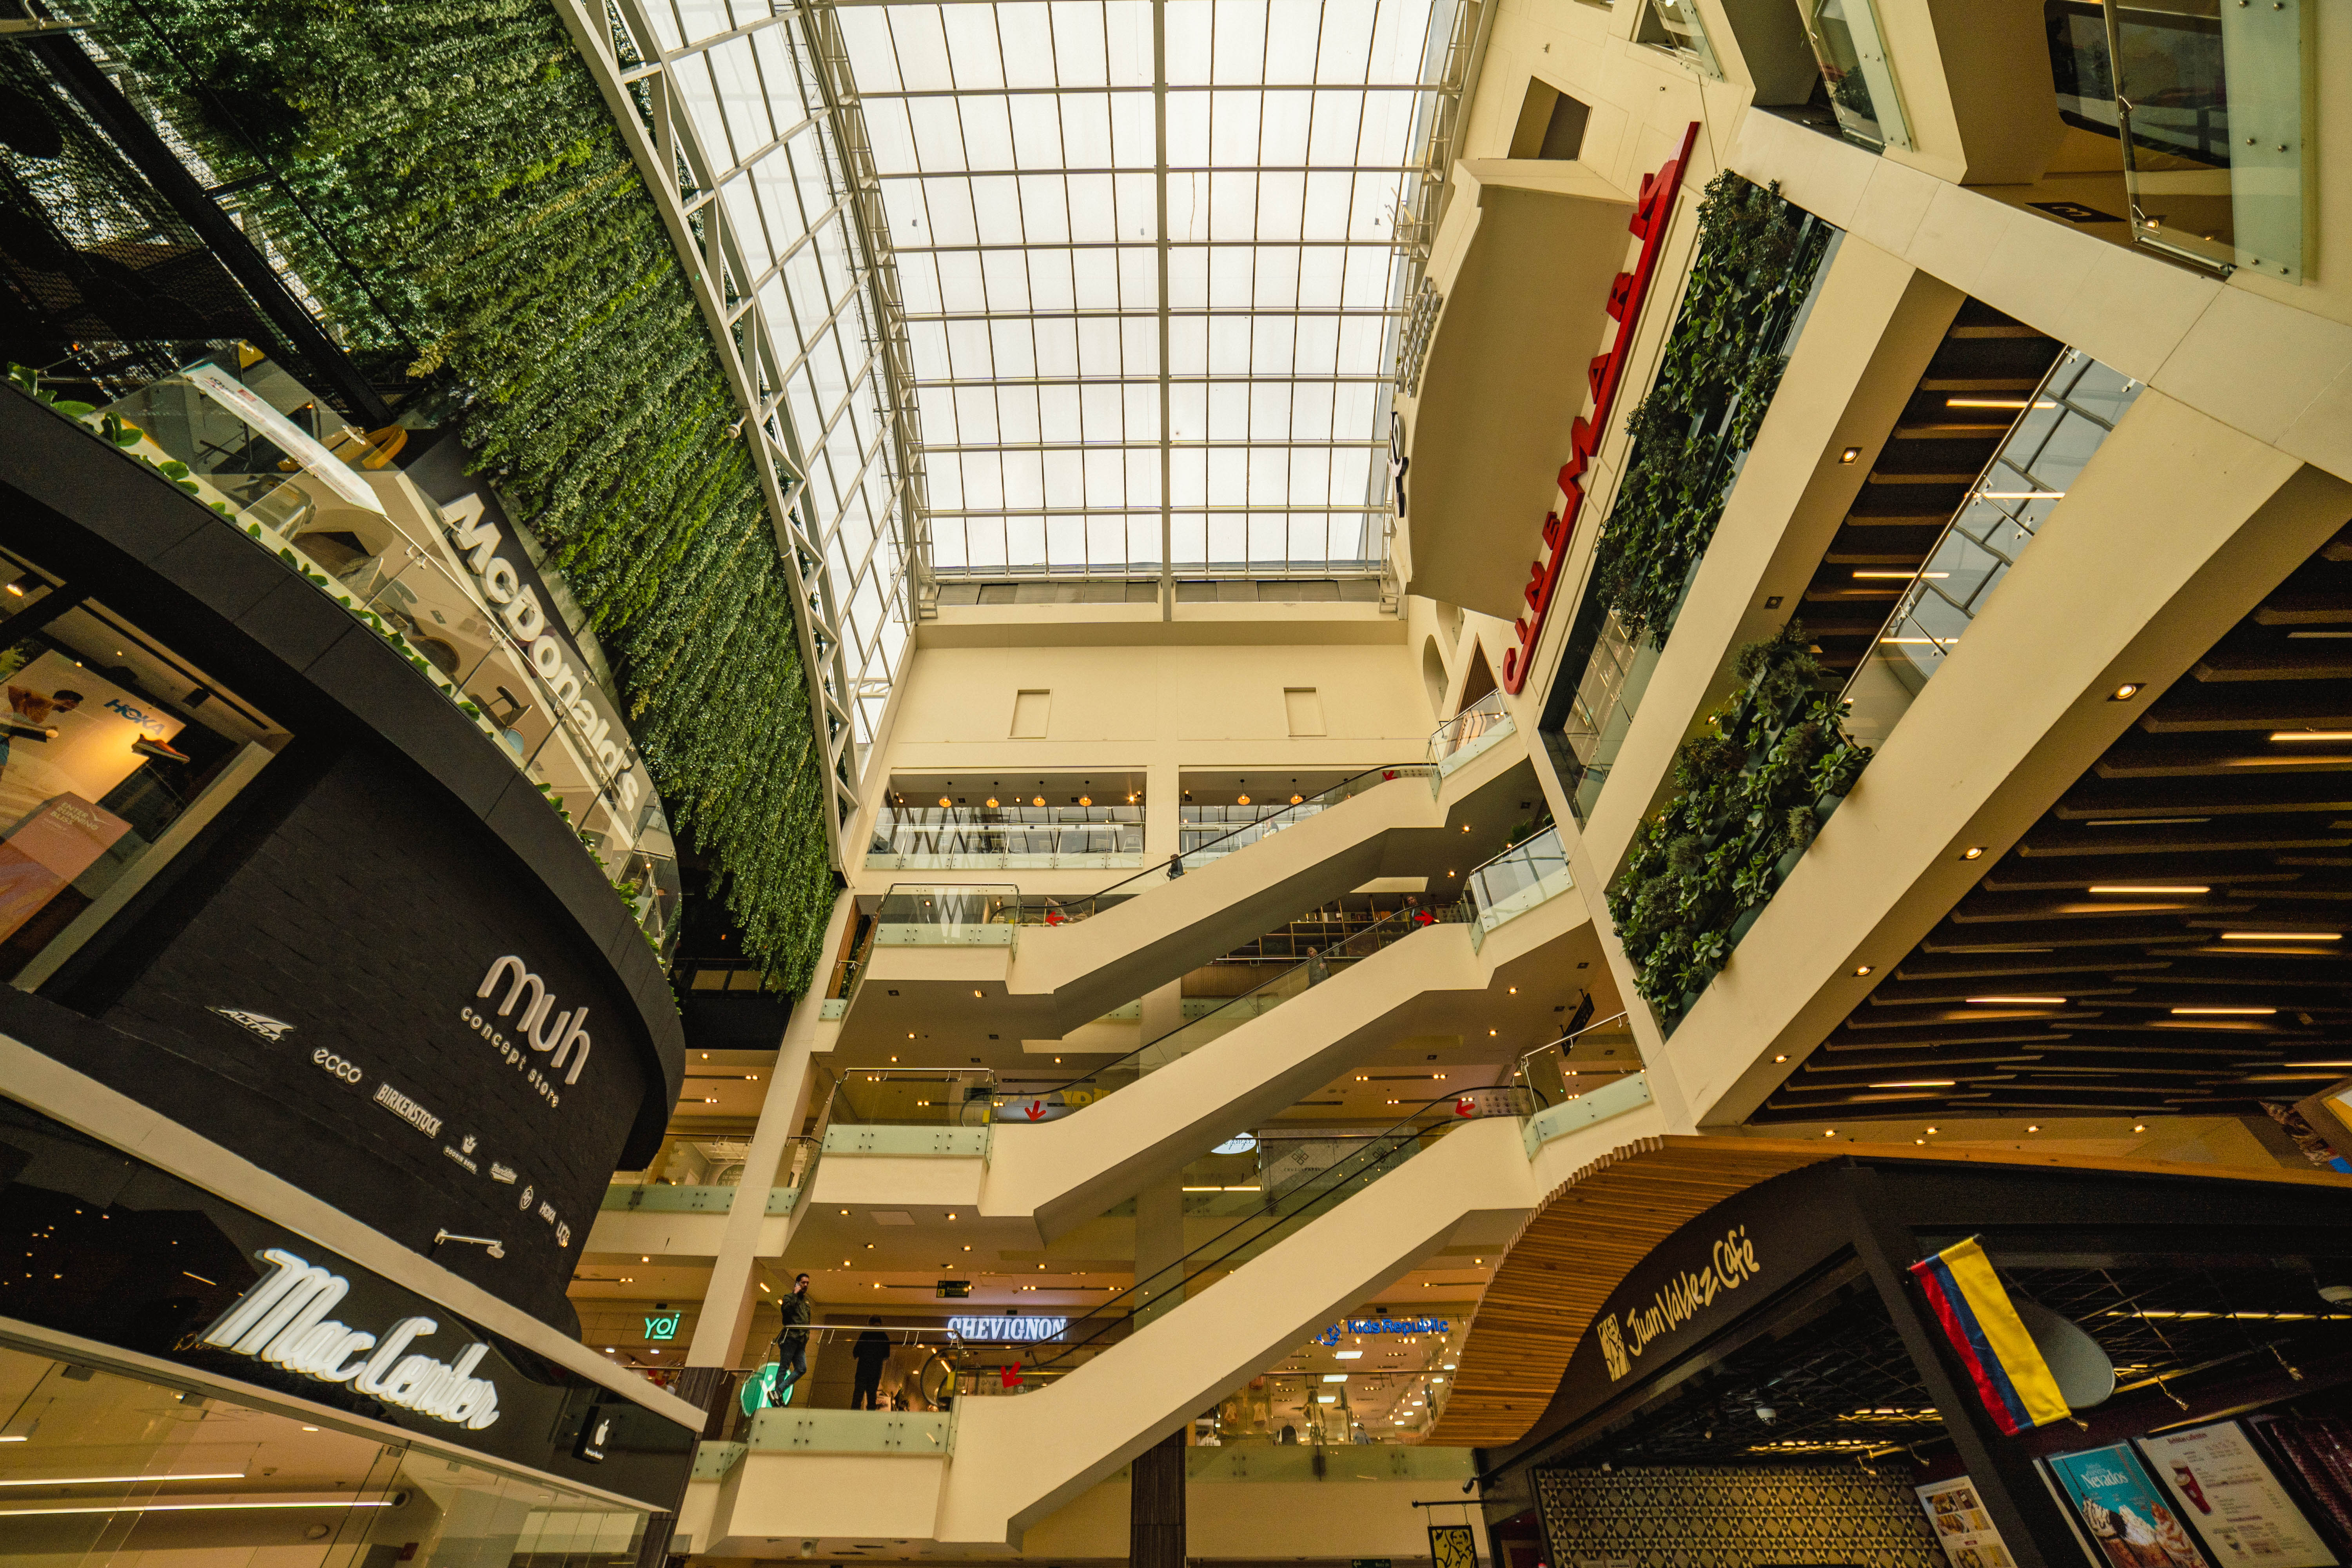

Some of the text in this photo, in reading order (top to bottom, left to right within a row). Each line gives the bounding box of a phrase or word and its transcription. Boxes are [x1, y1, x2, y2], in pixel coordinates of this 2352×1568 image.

[1503, 122, 1699, 695] CINEMARK
[436, 492, 639, 811] McDonald's
[103, 699, 166, 736] HOKA
[61, 802, 89, 818] ENTER
[219, 1009, 282, 1042] ALTRA
[477, 955, 590, 1084] muh
[312, 1047, 362, 1084] ecco
[460, 1006, 559, 1108] concept store
[376, 1083, 443, 1138] BIRKENSTOCK
[445, 1147, 464, 1164] GOORIN
[539, 1202, 557, 1225] HOKA
[1627, 1307, 1665, 1357] Juan
[1713, 1225, 1760, 1289] Café
[947, 1317, 1067, 1340] CHEVIGNON
[1348, 1318, 1449, 1337] Kids Republic
[348, 1317, 499, 1430] Center
[2081, 1470, 2129, 1489] Nevados
